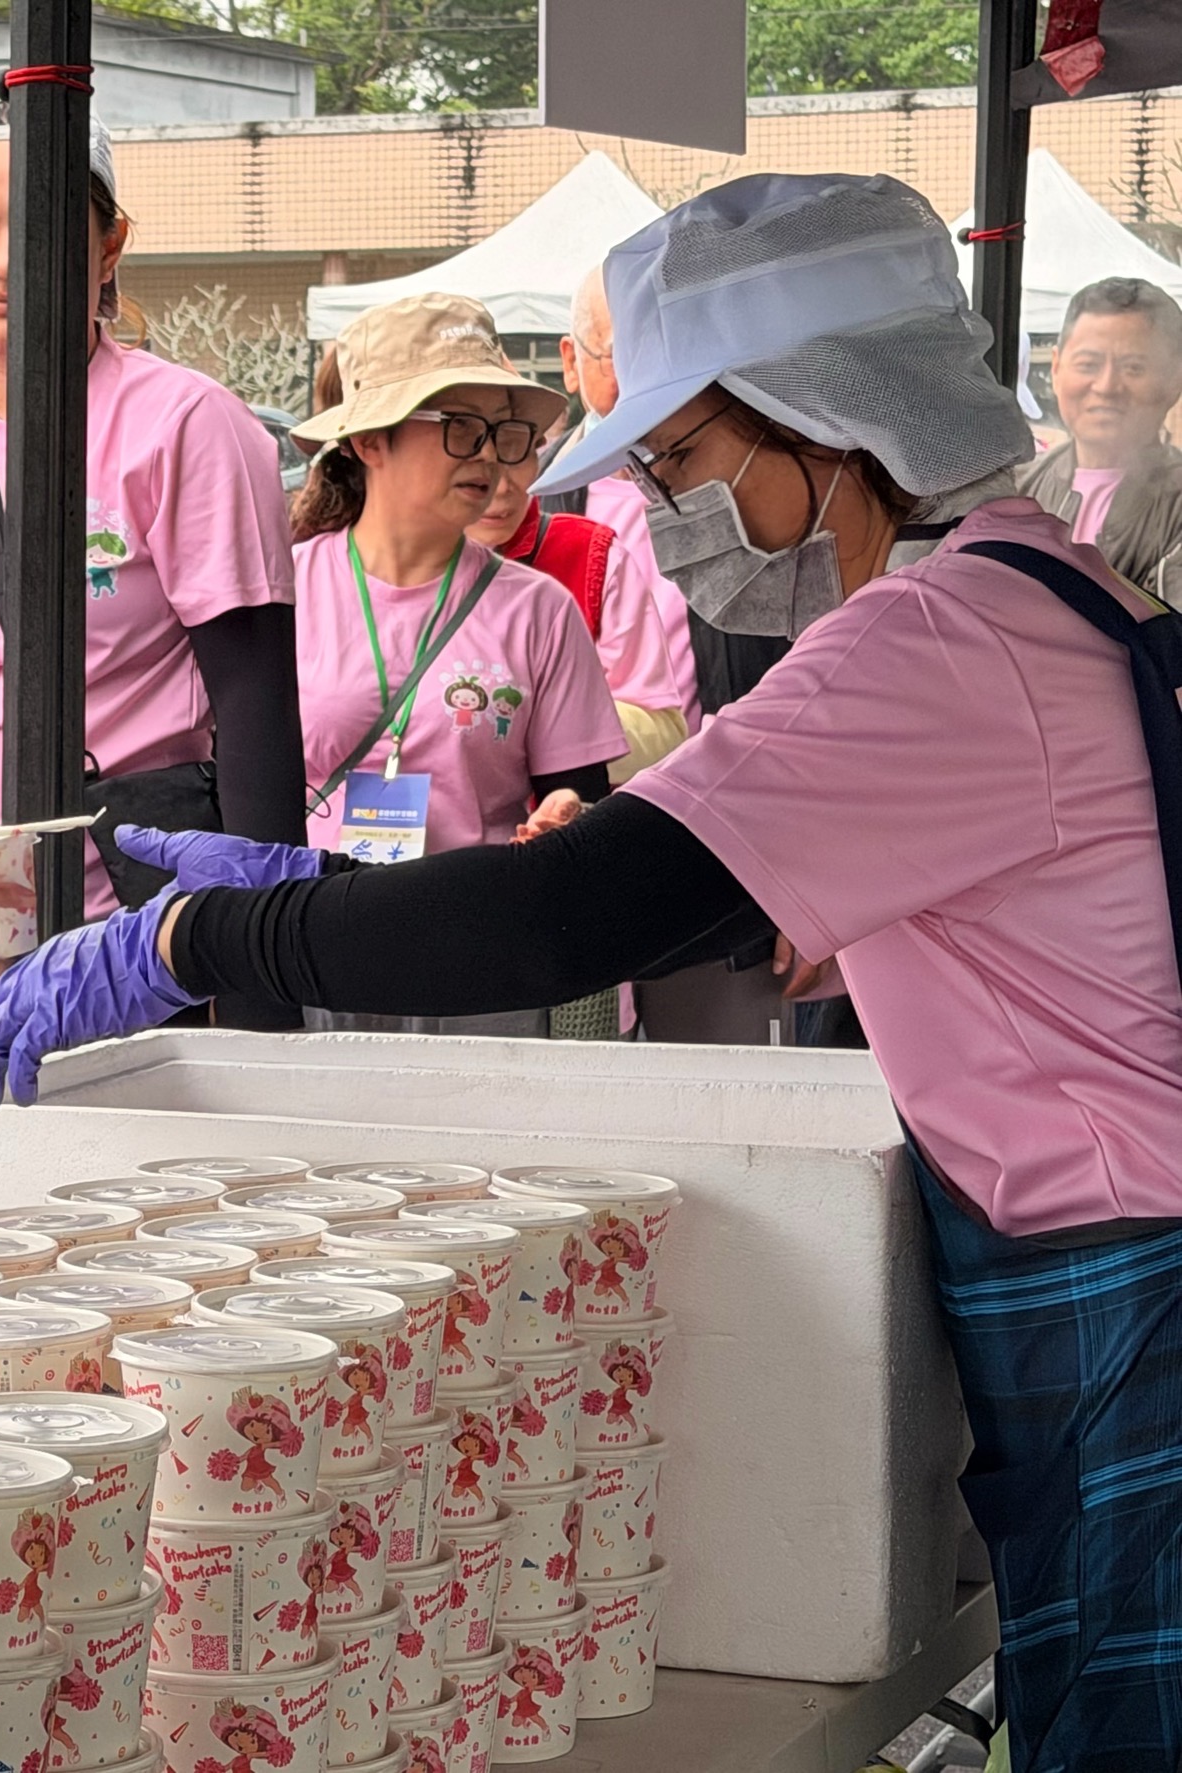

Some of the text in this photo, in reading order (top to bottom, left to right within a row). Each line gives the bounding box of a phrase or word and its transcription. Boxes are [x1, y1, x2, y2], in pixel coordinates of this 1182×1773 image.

[66, 1480, 126, 1512] Shortcake
[163, 1544, 232, 1563] Strawberry
[171, 1560, 232, 1582] Shortcake
[87, 1621, 144, 1657] Strawberry
[280, 1680, 329, 1715] Strawberry
